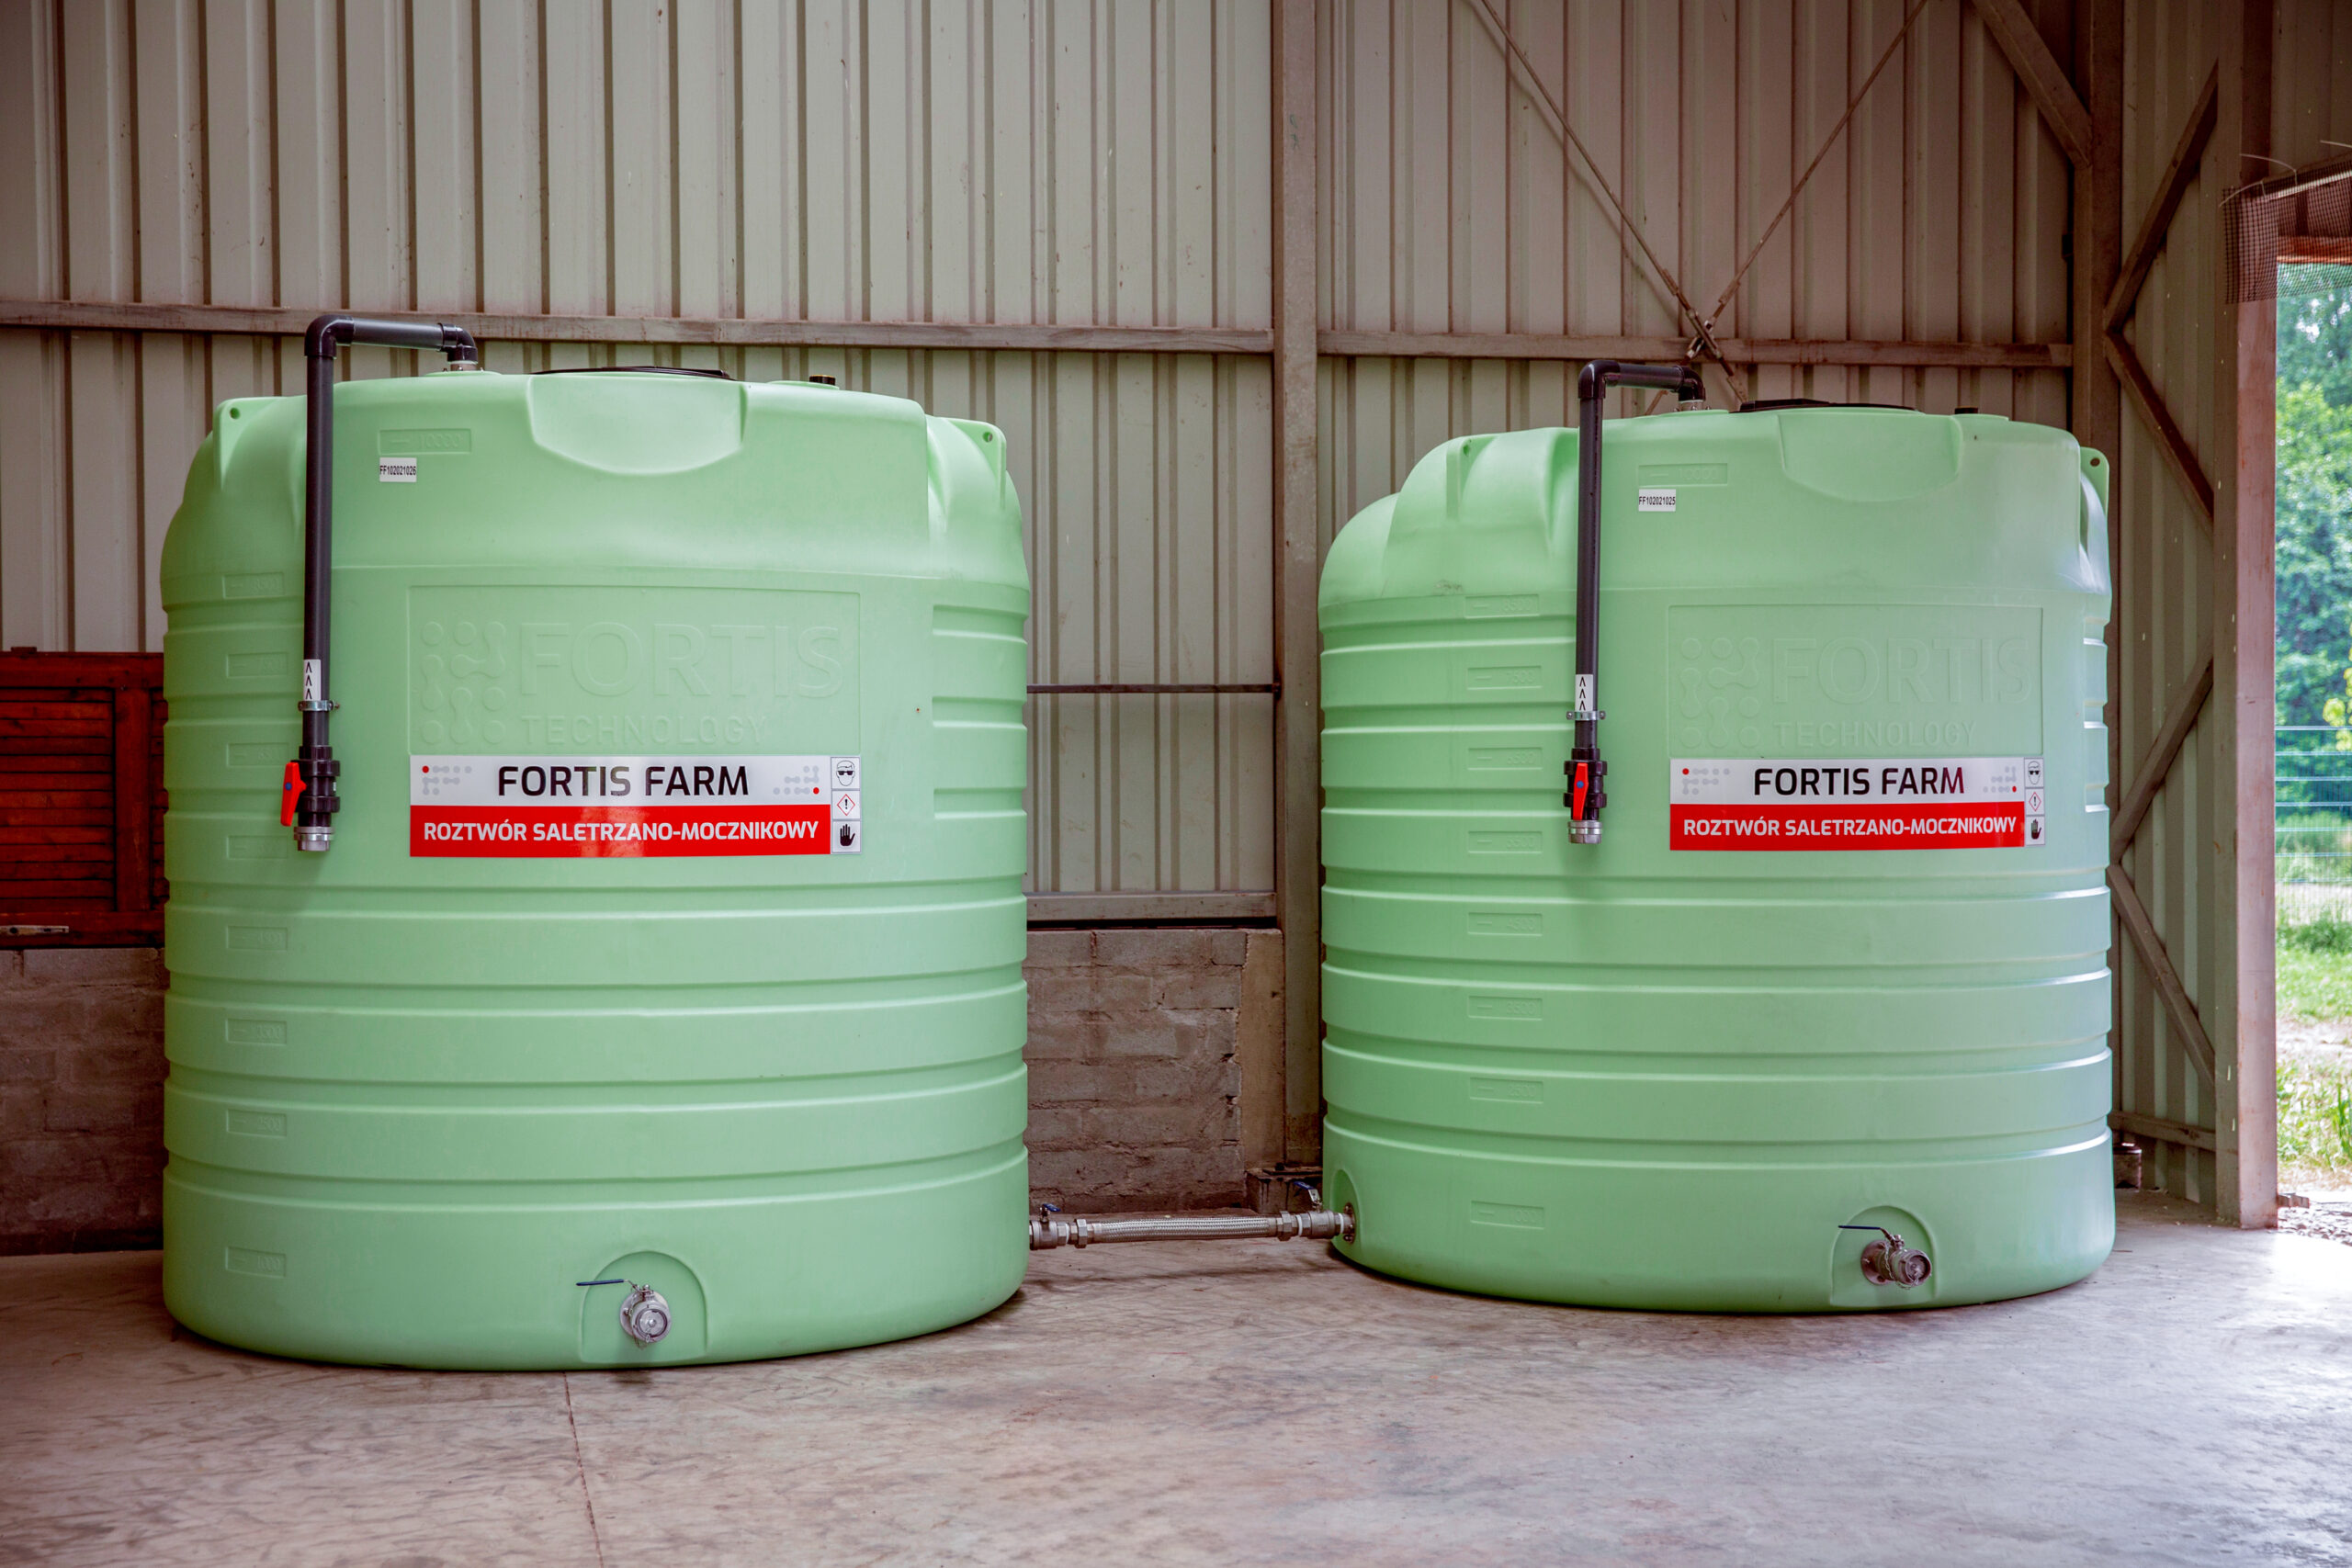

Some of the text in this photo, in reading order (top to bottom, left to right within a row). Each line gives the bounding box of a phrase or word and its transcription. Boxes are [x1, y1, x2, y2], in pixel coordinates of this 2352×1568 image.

[379, 465, 417, 476] FF102021026
[1638, 496, 1676, 506] FF102021025
[520, 622, 843, 698] FORTIS
[1772, 637, 2032, 705] FORTIS
[521, 716, 767, 746] TECHNOLOGY
[1774, 721, 1977, 749] TECHNOLOGY
[499, 765, 749, 796] FORTIS FARM
[1755, 767, 1965, 795] FORTIS FARM
[424, 818, 819, 841] ROZTWÓR SALETRZANO-MOCZNIKOWY
[1684, 816, 2017, 836] ROZTWÓR SALETRZANO-MOCZNIKOWY
